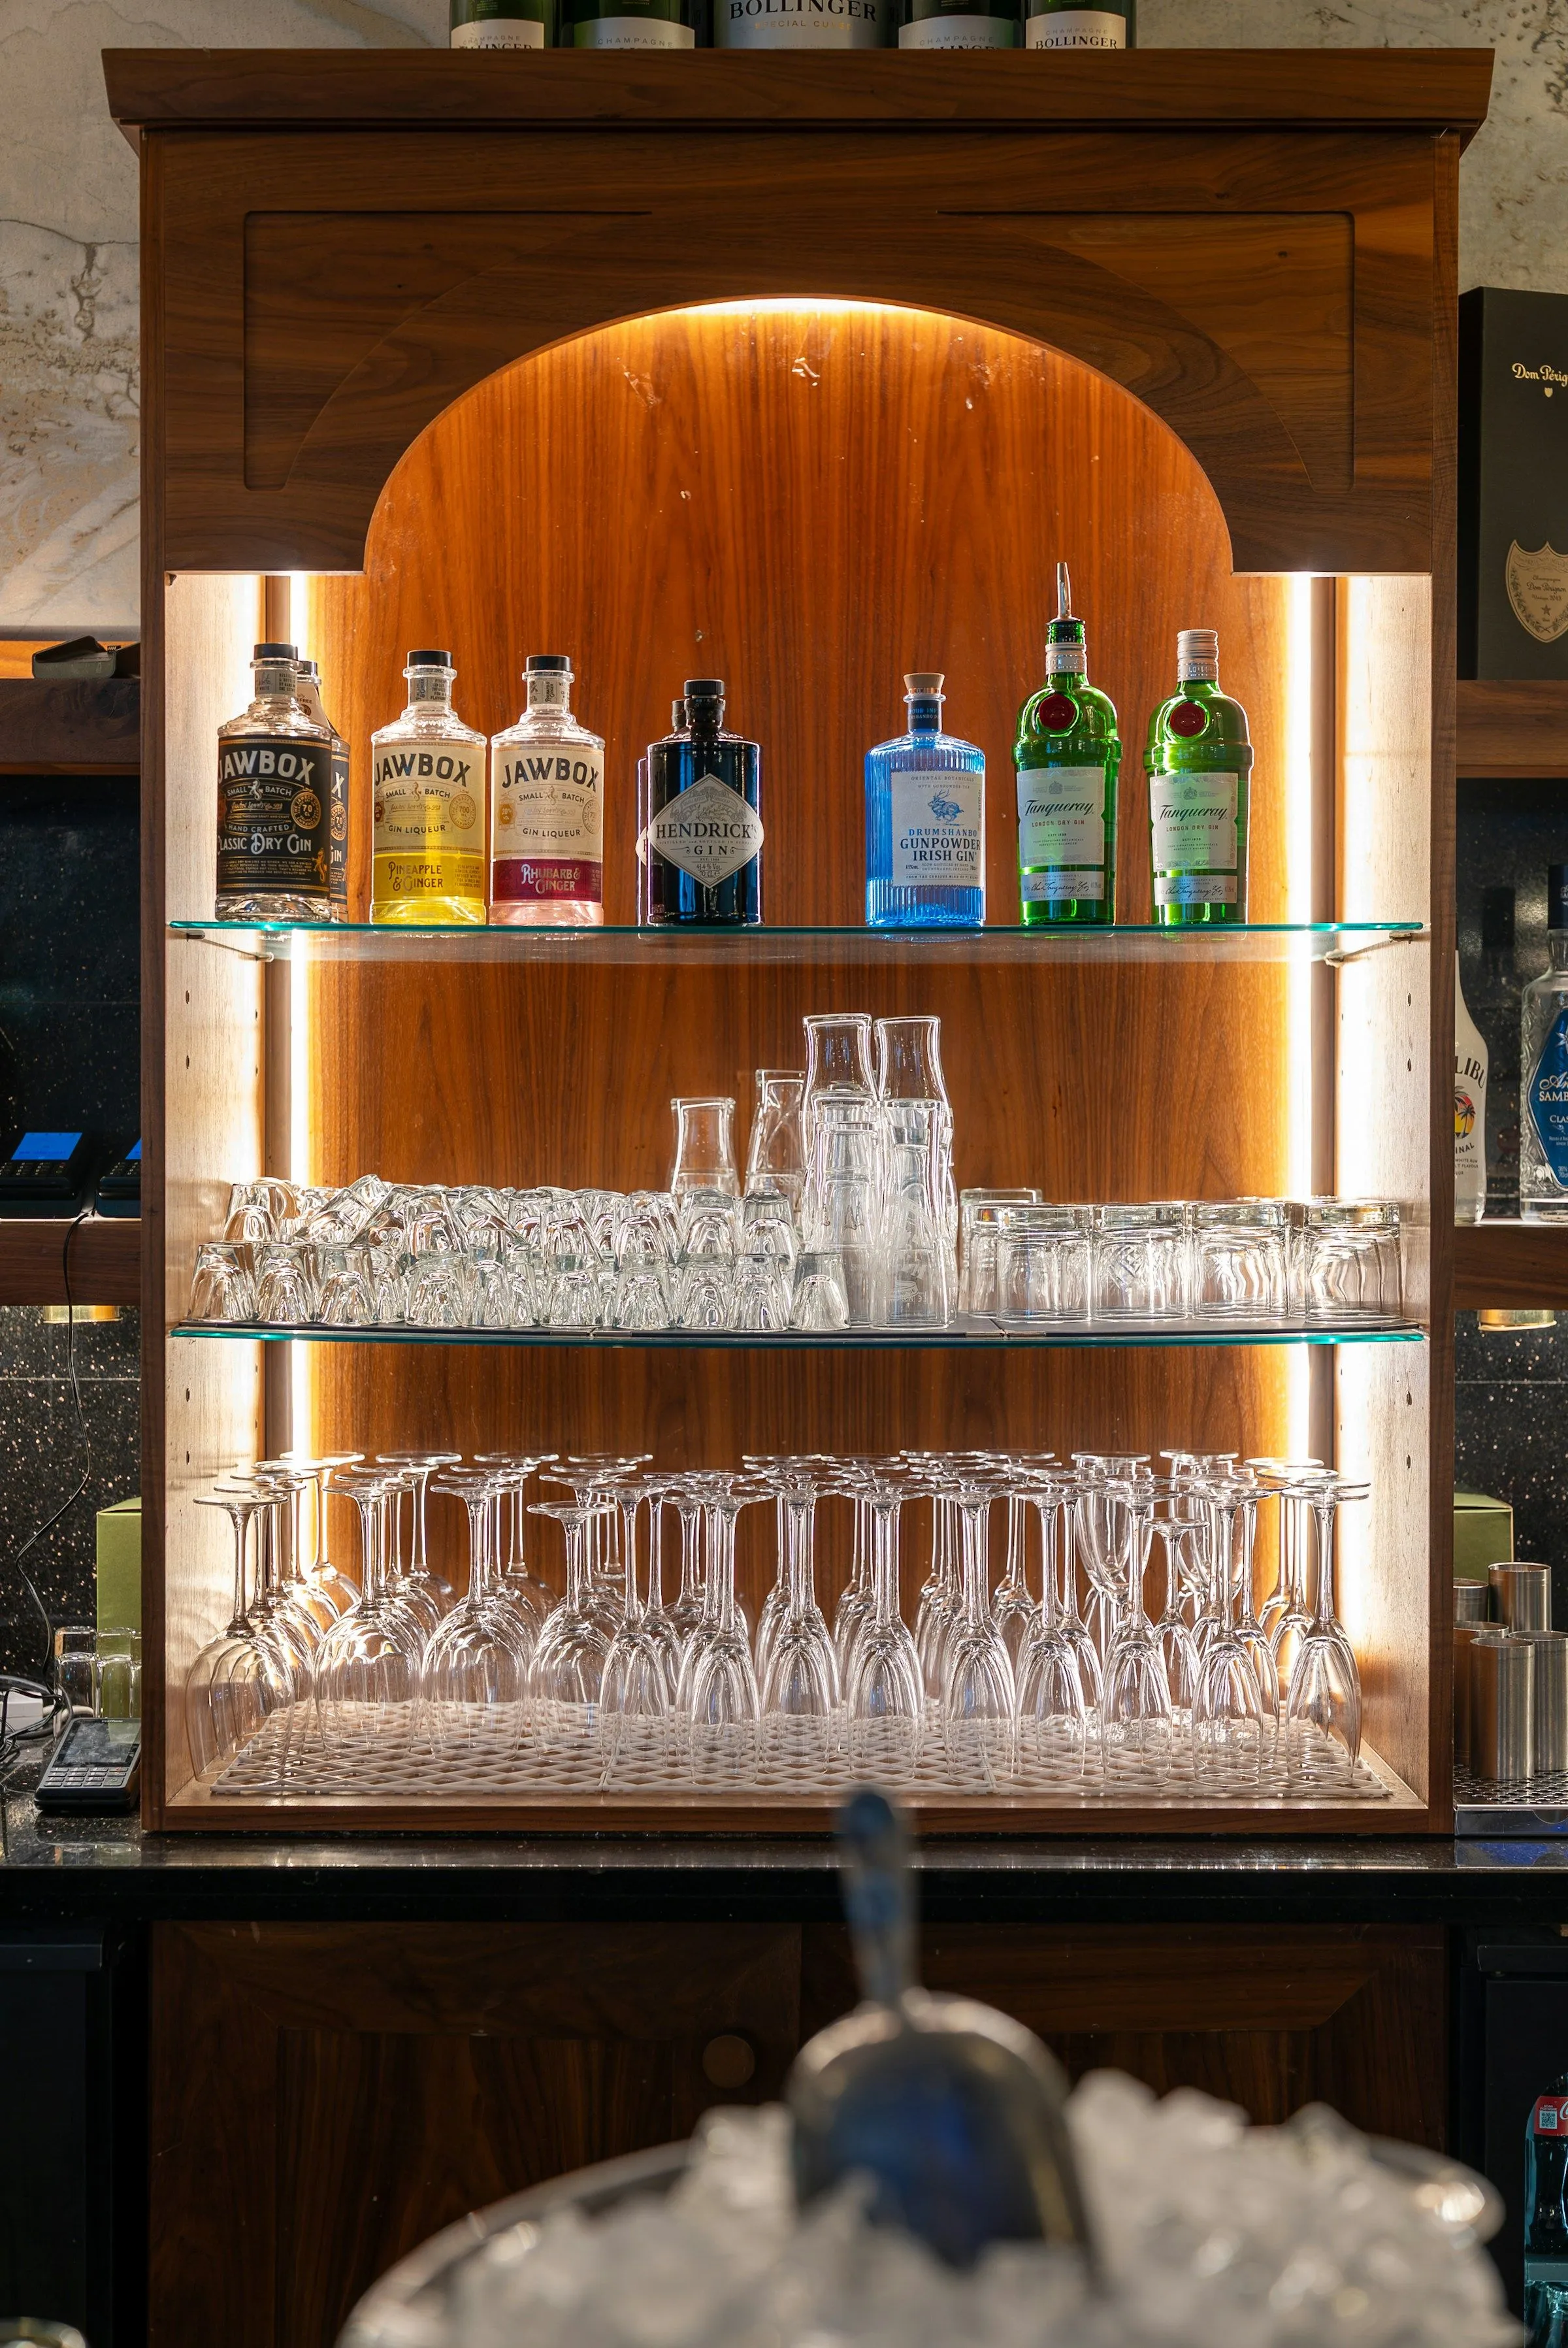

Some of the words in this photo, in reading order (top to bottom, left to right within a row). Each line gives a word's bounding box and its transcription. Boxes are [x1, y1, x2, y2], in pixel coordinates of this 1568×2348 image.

[730, 0, 877, 22] BOLLINGER
[463, 35, 521, 45] CHAMPAGNE
[598, 37, 675, 48] CHAMPAGNE
[920, 36, 994, 46] CHAMPAGNE
[1036, 36, 1117, 49] BOLLINGER
[1512, 363, 1540, 380] Dom
[1540, 365, 1568, 387] Périg
[218, 750, 315, 785] JAWBOX
[375, 753, 471, 787] JAWBOX
[502, 757, 599, 793] JAWBOX
[227, 786, 248, 797] SMALL
[265, 785, 292, 795] BATCH
[385, 788, 406, 799] SMALL
[425, 788, 451, 799] BATCH
[519, 791, 543, 801] SMALL
[562, 793, 585, 804] BATCH
[1024, 799, 1094, 816] Tanqueray
[1159, 804, 1228, 821] Tanqueray
[251, 824, 289, 833] CRAFTED
[405, 825, 446, 835] LIQUEUR
[523, 827, 538, 836] GIN
[542, 829, 581, 838] LIQUEUR
[656, 822, 758, 840] HENDRICK'S
[250, 833, 283, 855] DRY
[287, 834, 312, 854] GIN
[694, 845, 728, 855] GIN
[900, 837, 980, 850] GUNPOWDER
[913, 850, 952, 861] IRISH
[388, 861, 442, 880] PINEAPPLE
[521, 863, 573, 885] RHUBARB
[573, 867, 581, 880] &
[393, 877, 402, 891] &
[403, 876, 444, 891] GINGER
[535, 878, 576, 894] GINGER
[1455, 1055, 1486, 1089] LIBU
[1539, 1091, 1568, 1102] SAMB
[1550, 1115, 1568, 1123] CLAS
[1456, 1142, 1475, 1154] INAL
